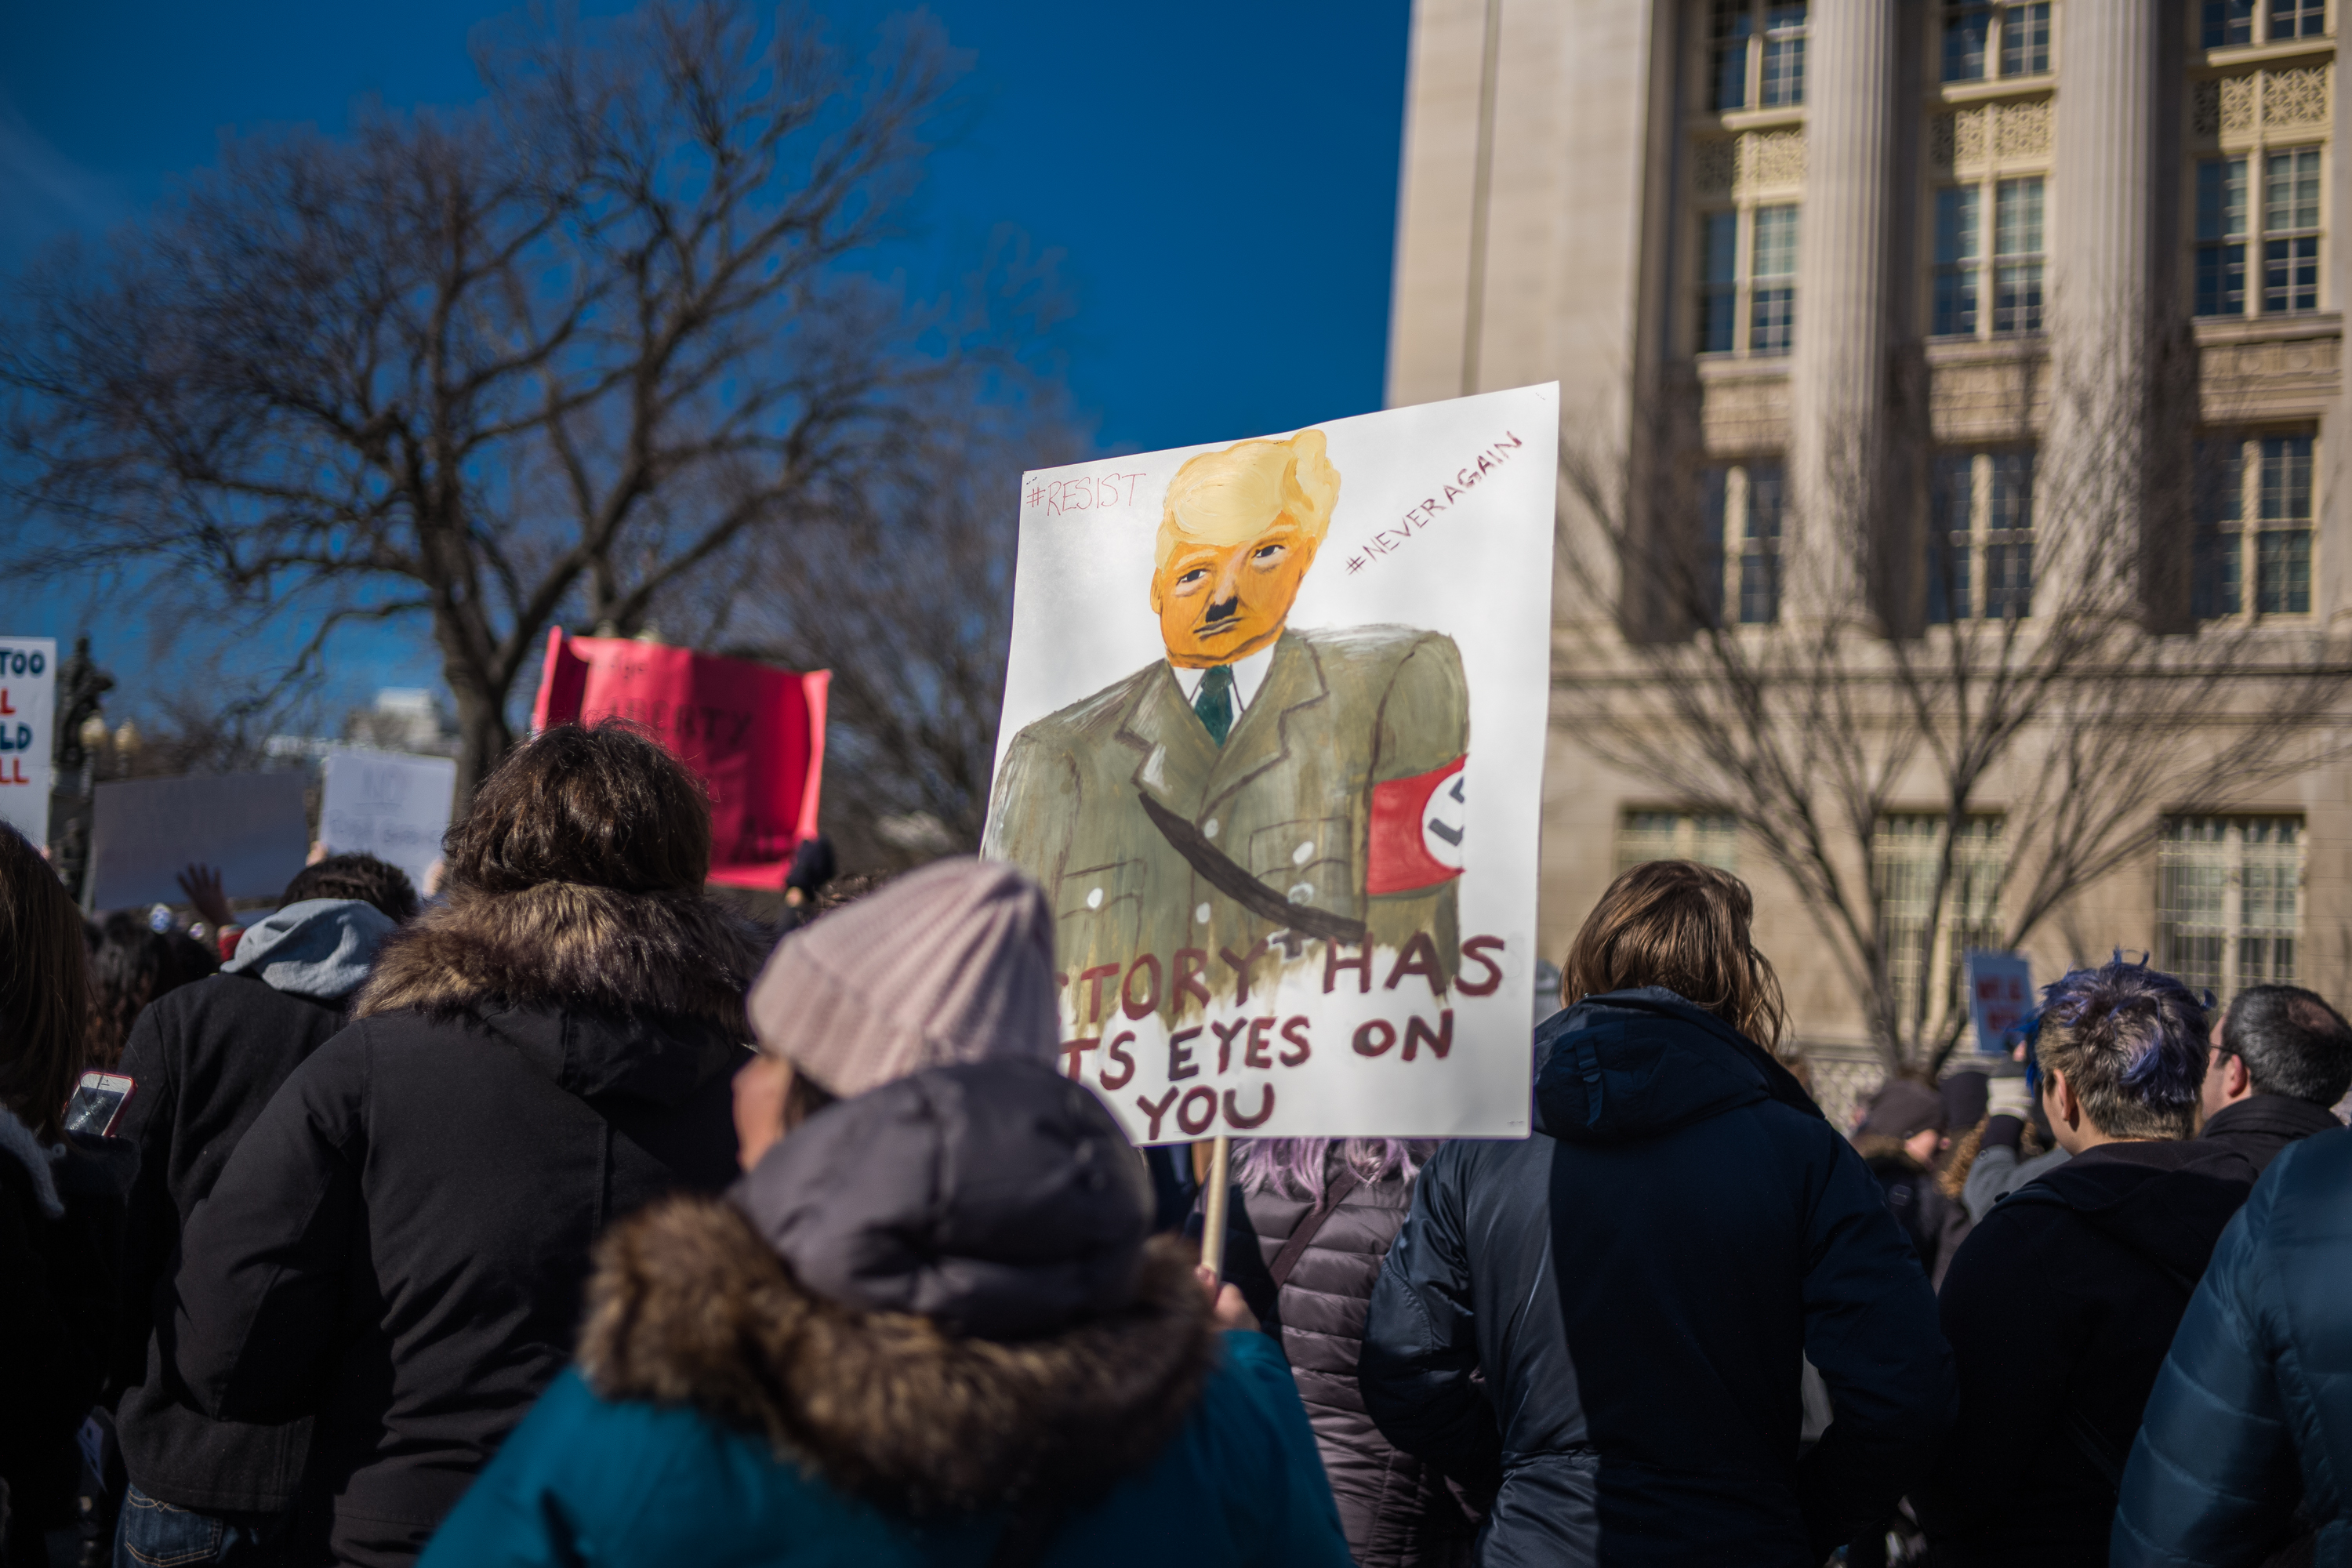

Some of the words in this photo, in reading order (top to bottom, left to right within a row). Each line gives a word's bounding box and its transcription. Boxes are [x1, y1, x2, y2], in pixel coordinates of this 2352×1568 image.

[1026, 473, 1146, 516] #RESIST
[1057, 938, 1269, 1022] TORY
[1323, 932, 1504, 996] HAS
[1058, 1031, 1136, 1091] TS
[1168, 1014, 1311, 1082] EYES
[1352, 1007, 1454, 1062] ON
[1136, 1082, 1275, 1141] YOU
